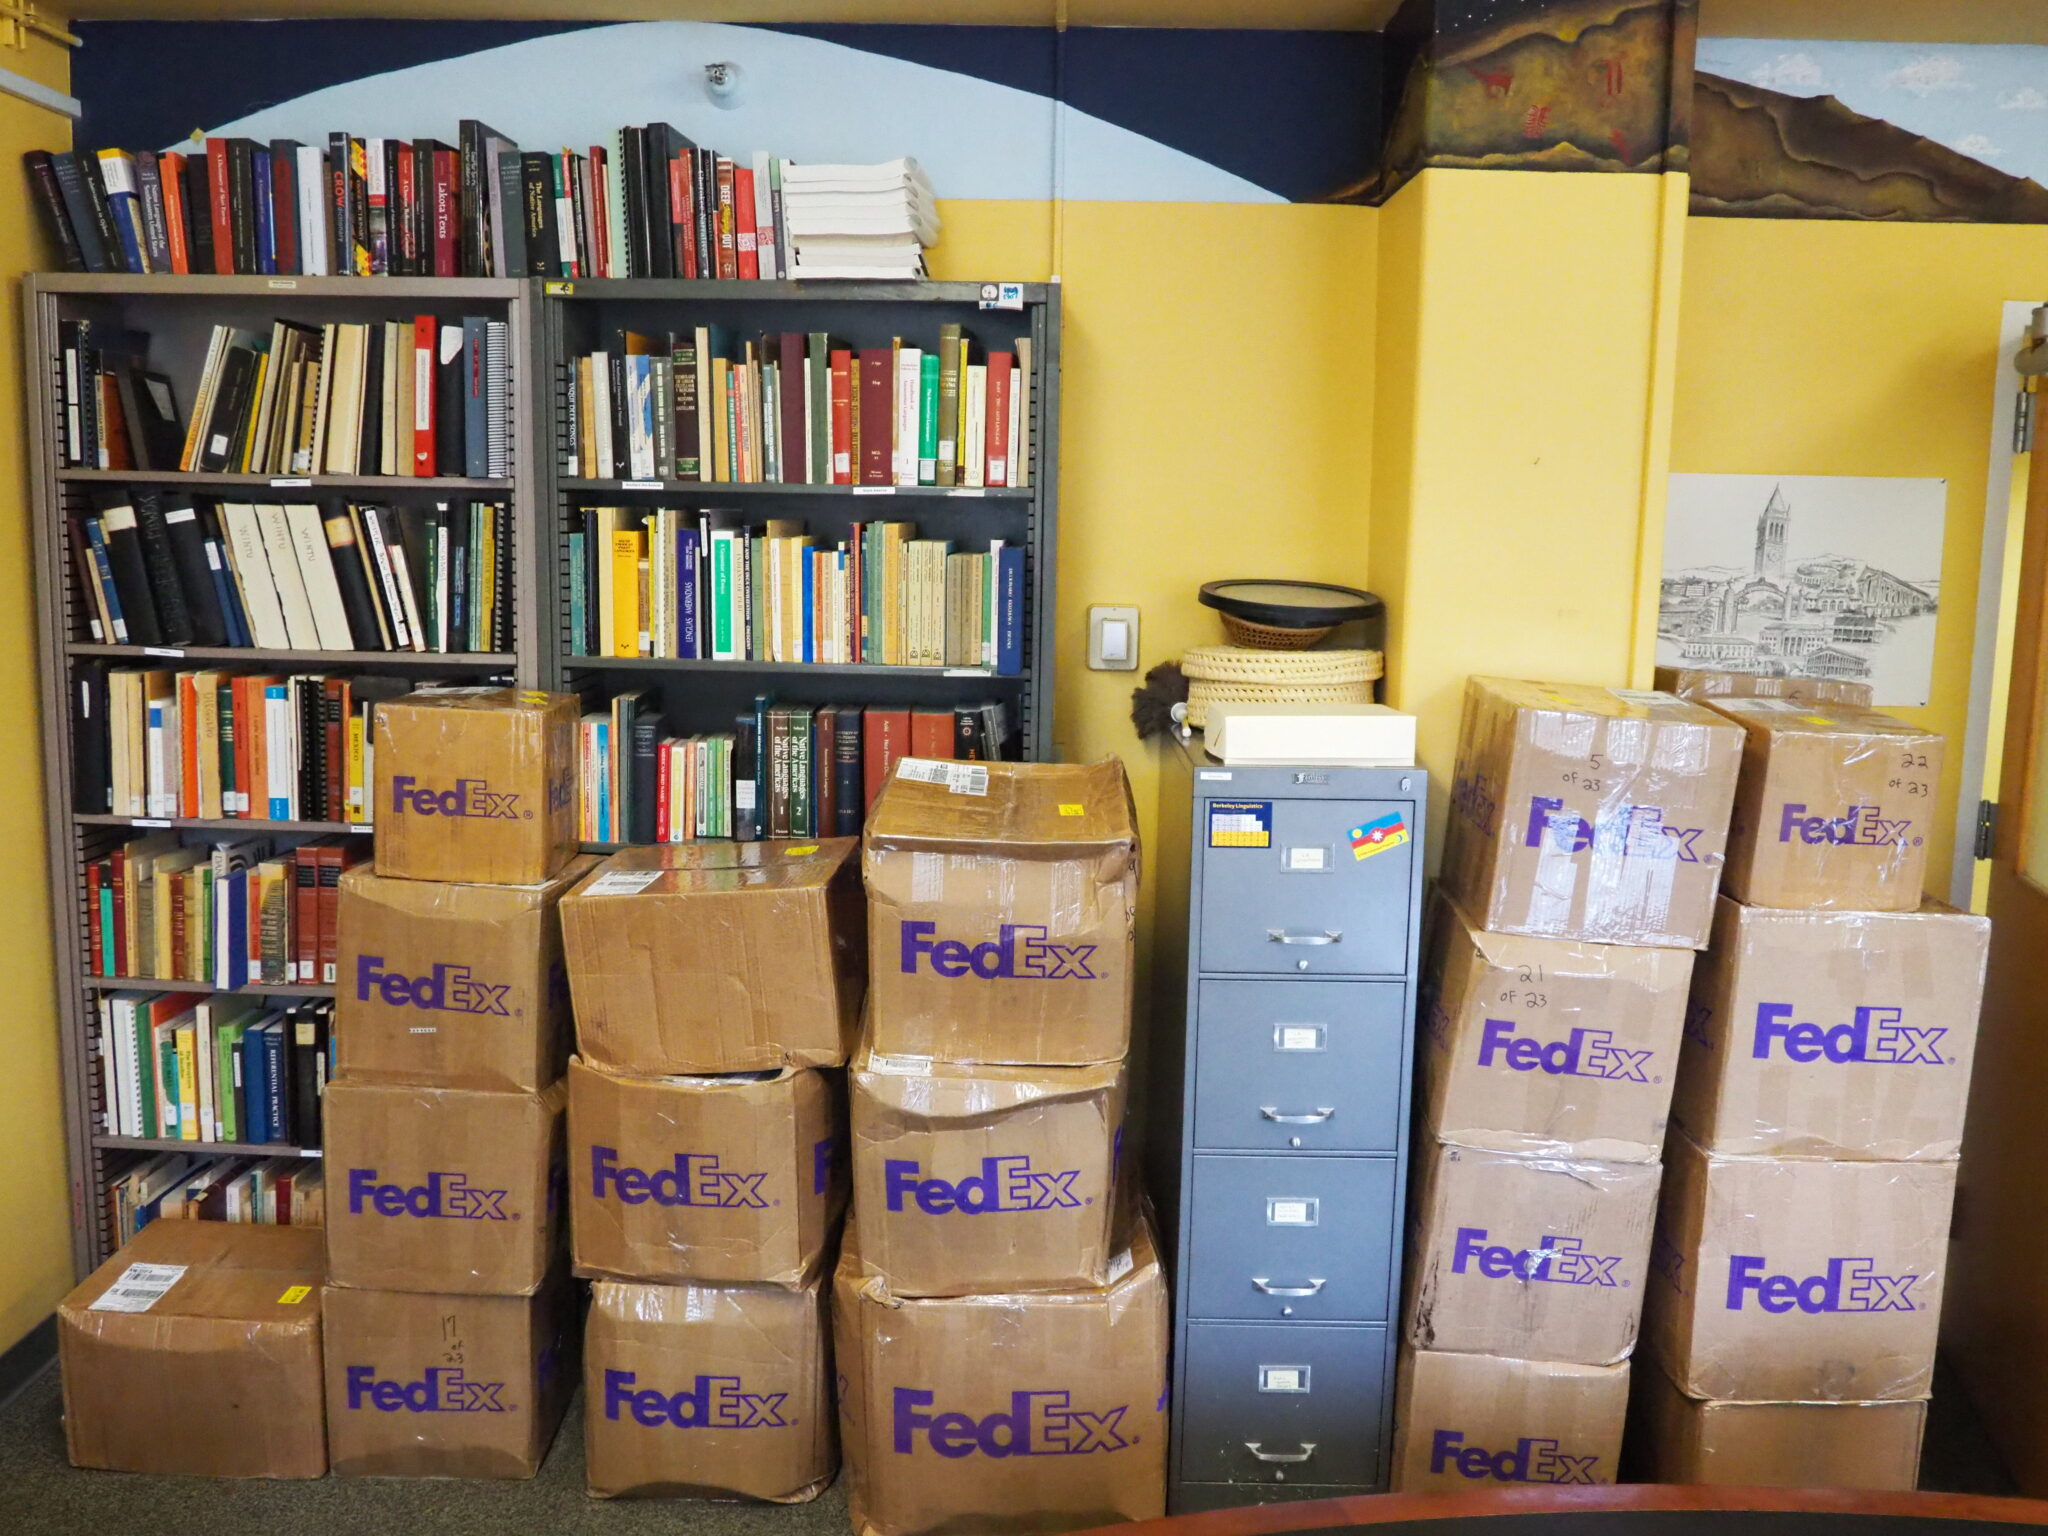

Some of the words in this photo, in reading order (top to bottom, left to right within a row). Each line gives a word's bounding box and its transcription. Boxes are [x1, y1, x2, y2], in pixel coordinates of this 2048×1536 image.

[143, 184, 154, 220] Southeastern
[151, 184, 160, 202] Native
[334, 170, 345, 208] CROW
[438, 182, 447, 213] Lakota
[529, 190, 537, 211] Native
[697, 170, 705, 211] Cherokee
[720, 184, 731, 204] DEEP
[152, 203, 162, 232] Languages
[336, 207, 345, 242] dictionary
[439, 214, 448, 239] Texts
[530, 212, 538, 238] America
[535, 195, 544, 228] Languages
[148, 220, 157, 240] United
[157, 240, 166, 249] the
[699, 212, 708, 258] Narratives
[722, 234, 732, 249] OUT
[151, 240, 159, 257] States
[567, 382, 576, 402] YAQUI
[239, 525, 254, 559] WINTU
[271, 513, 286, 550] WINTU
[301, 527, 316, 562] WINTU
[684, 581, 693, 614] AMERINDIAS
[736, 583, 742, 592] OF
[685, 617, 694, 643] LENGUAS
[775, 736, 781, 744] of
[782, 736, 790, 759] Native
[792, 736, 799, 744] of
[799, 736, 807, 760] Native
[774, 757, 782, 793] Americas
[1589, 753, 1604, 770] 5
[1901, 753, 1929, 769] 22
[781, 759, 790, 799] Languages
[799, 760, 808, 799] Languages
[1562, 771, 1578, 784] of
[1583, 778, 1601, 792] 23
[1888, 778, 1901, 789] of
[1908, 781, 1929, 797] 23
[393, 776, 520, 819] FedEx
[796, 806, 802, 816] 2
[1525, 796, 1704, 863] FedEx
[1779, 804, 1912, 848] FedEx
[901, 921, 1096, 979] FedEx
[357, 954, 511, 1016] FedEx
[1519, 966, 1544, 983] 21
[1526, 992, 1548, 1008] 23
[1752, 1002, 1948, 1065] FedEx
[1478, 1018, 1654, 1083] FedEx
[270, 1049, 278, 1093] REFERENTIAL
[271, 1096, 279, 1127] PRACTICE
[591, 1145, 768, 1208] FedEx
[885, 1155, 1081, 1215] FedEx
[349, 1169, 507, 1219] FedEx
[1451, 1227, 1622, 1287] FedEx
[1725, 1254, 1920, 1315] FedEx
[347, 1366, 506, 1412] FedEx
[605, 1369, 788, 1429] FedEx
[893, 1387, 1129, 1459] FedEx
[1430, 1429, 1599, 1485] FedEx
